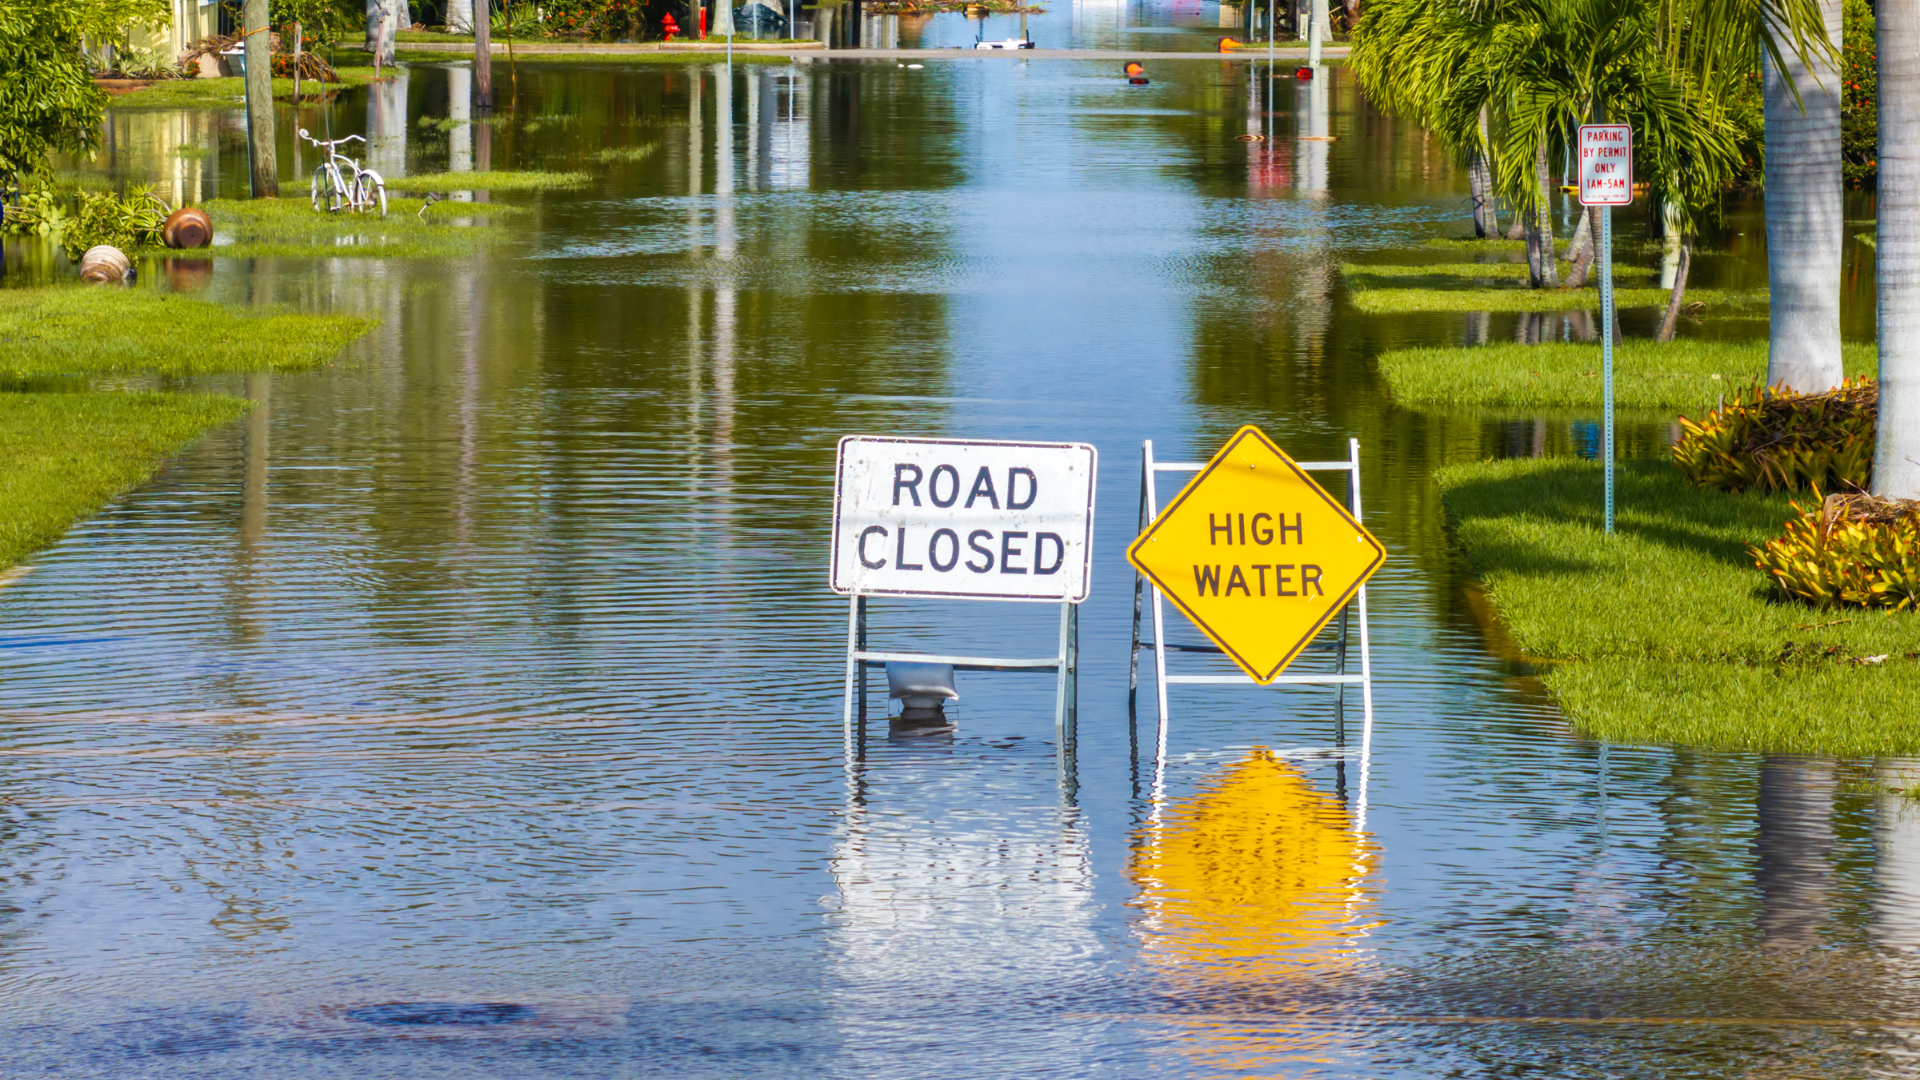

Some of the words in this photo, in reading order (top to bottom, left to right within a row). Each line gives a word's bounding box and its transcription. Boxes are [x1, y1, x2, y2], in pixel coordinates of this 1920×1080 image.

[1587, 131, 1623, 142] PARKING
[1583, 147, 1595, 158] BY
[1597, 147, 1627, 158] PERMIT
[1594, 163, 1616, 174] ONLY
[1586, 178, 1625, 189] 1AM-5AM
[893, 463, 1037, 510] ROAD
[1209, 512, 1303, 545] HIGH
[858, 525, 1065, 576] CLOSED
[1193, 563, 1324, 597] WATER
